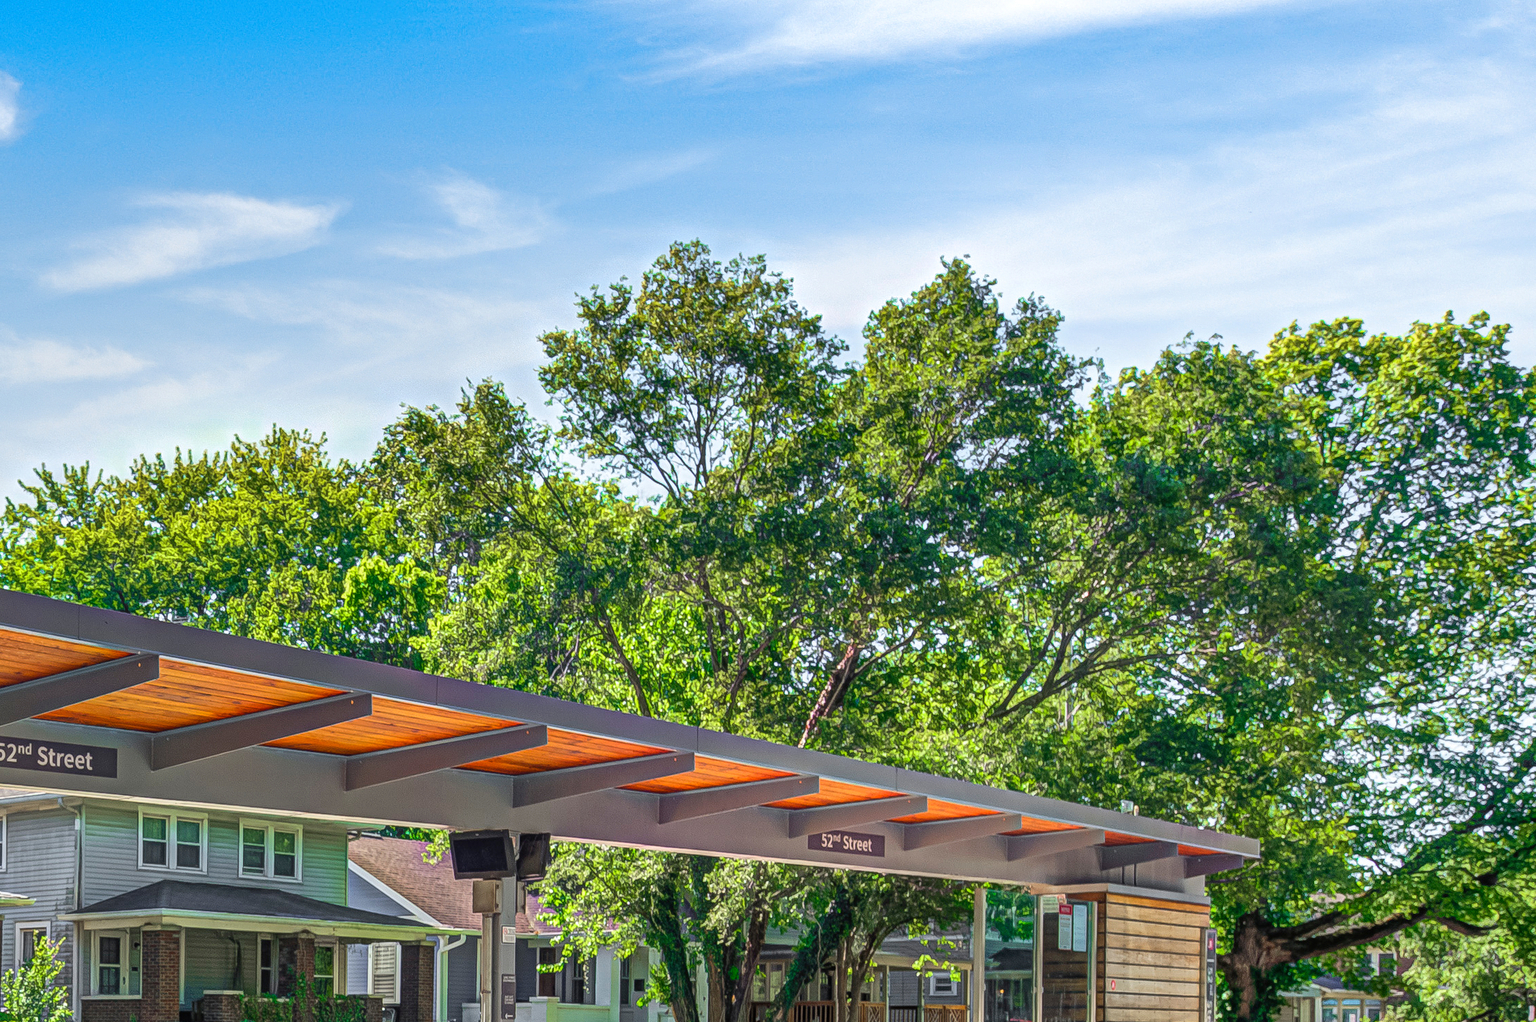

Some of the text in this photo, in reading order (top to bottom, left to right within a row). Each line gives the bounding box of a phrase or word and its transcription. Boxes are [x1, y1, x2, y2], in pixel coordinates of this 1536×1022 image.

[37, 746, 93, 771] Street
[821, 833, 872, 852] 52nd Street
